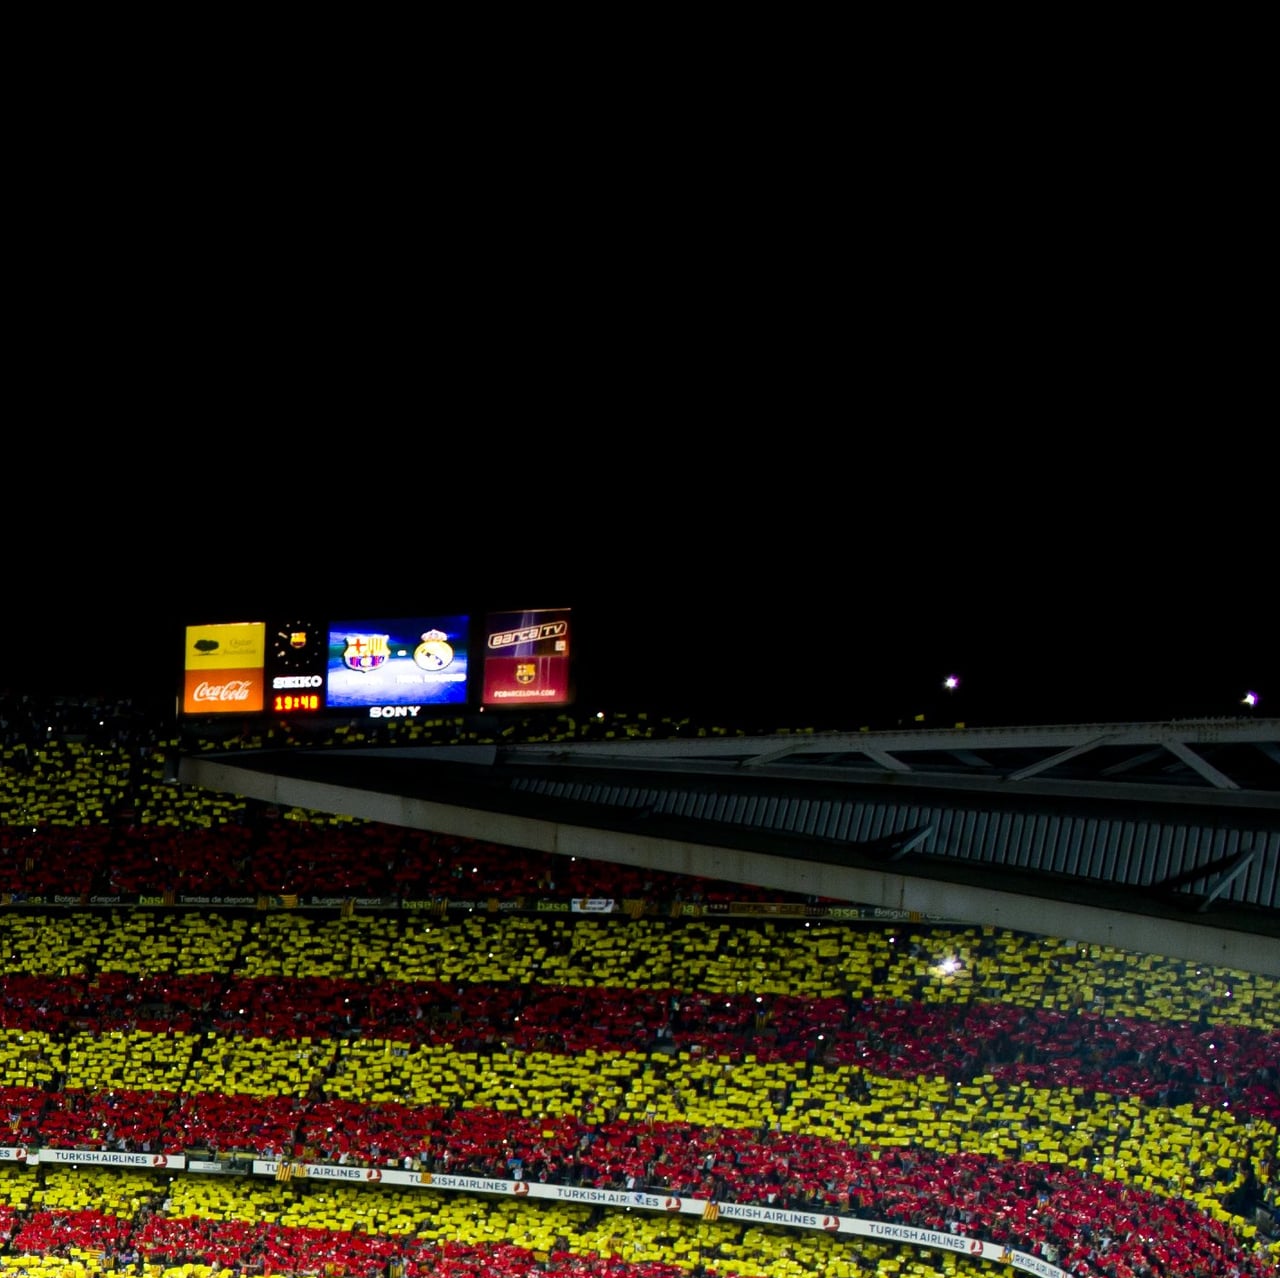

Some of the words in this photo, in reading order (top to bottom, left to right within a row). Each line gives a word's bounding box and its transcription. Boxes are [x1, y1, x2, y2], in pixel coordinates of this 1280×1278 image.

[543, 623, 563, 636] TV
[272, 675, 323, 689] SEIKO
[369, 705, 421, 718] SONY
[55, 1151, 99, 1161] TURKISH
[101, 1153, 148, 1164] AIRLINES
[312, 1167, 361, 1179] AIRLINES
[409, 1174, 456, 1187] TUKISH
[458, 1179, 507, 1192] AIRLINES
[557, 1188, 606, 1201] TURKISH
[718, 1206, 763, 1220] URKISH
[765, 1210, 817, 1226] AIRLINES
[869, 1223, 918, 1240] TURKISH
[919, 1232, 966, 1249] AIRLINES
